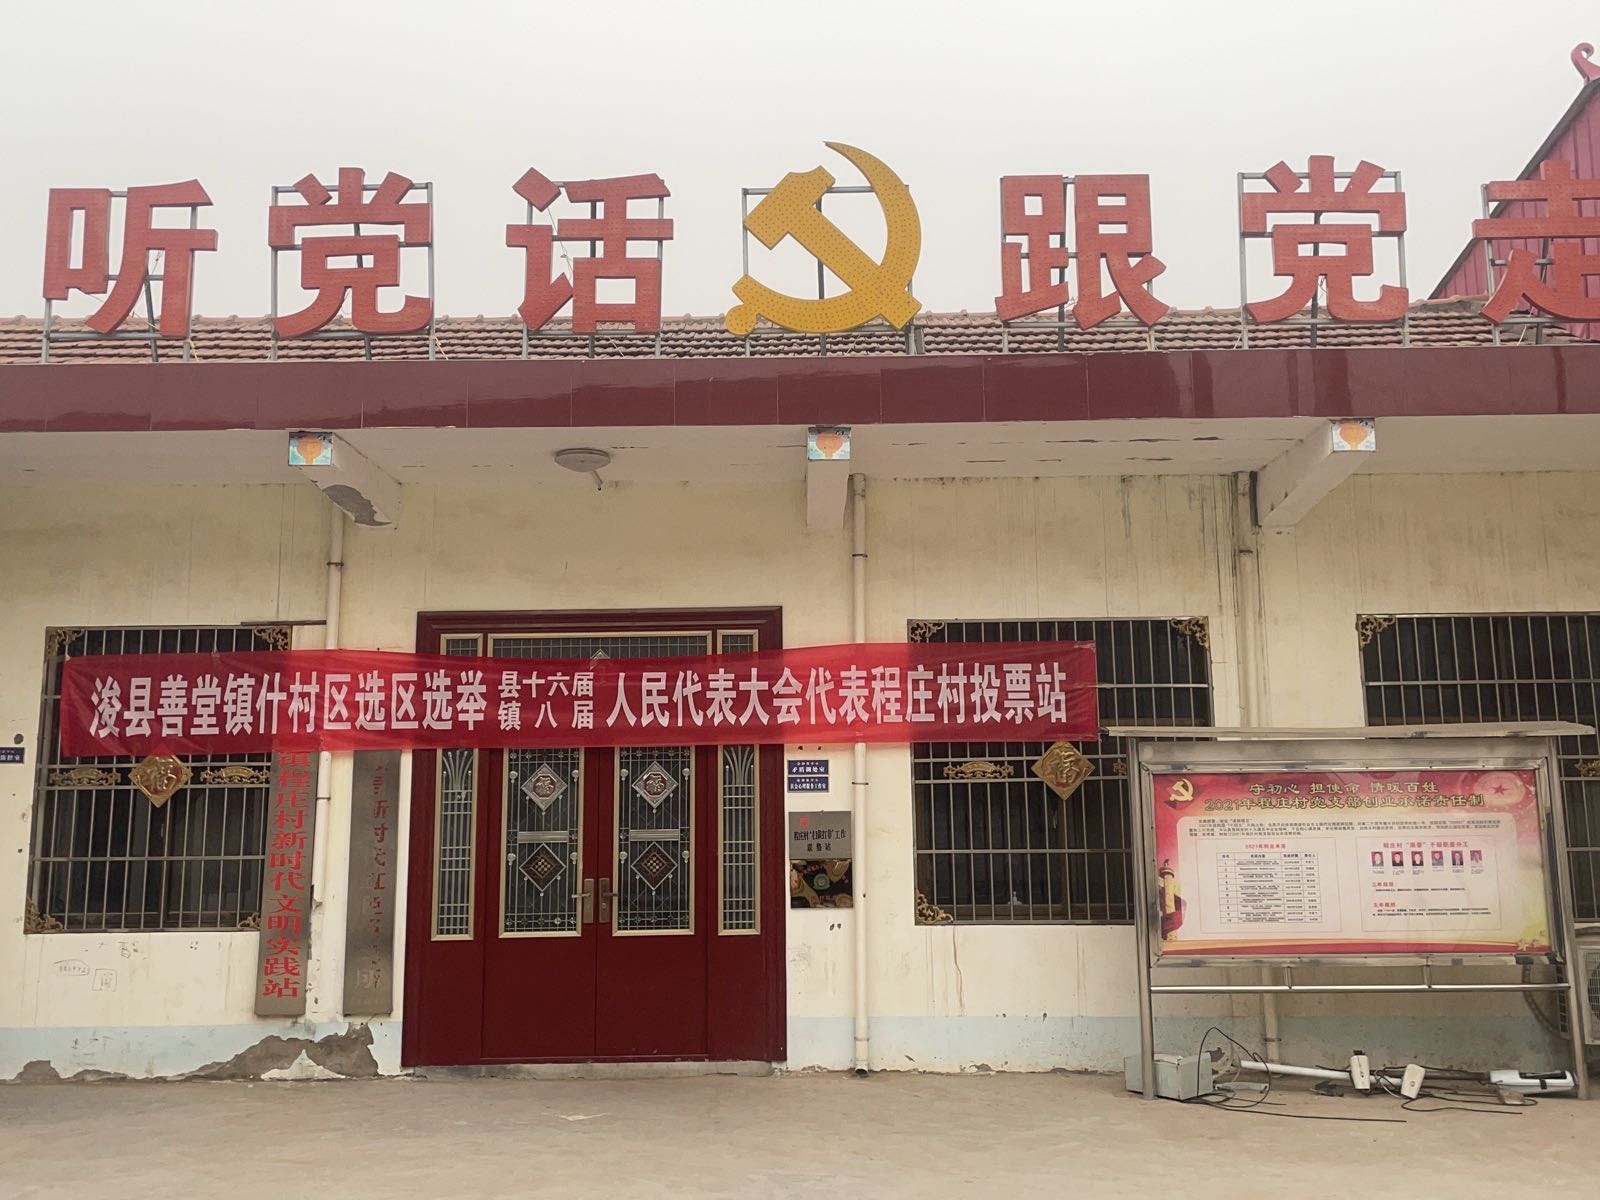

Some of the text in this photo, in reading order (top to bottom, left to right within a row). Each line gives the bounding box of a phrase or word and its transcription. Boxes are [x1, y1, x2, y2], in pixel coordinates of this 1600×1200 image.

[42, 155, 1600, 340] 听党话 跟党走
[89, 661, 1067, 738] 浚县善堂镇什村区选区选举 人民代表大会代表程庄村投票站
[497, 670, 594, 699] 县十六届
[497, 700, 594, 731] 镇八届
[1249, 781, 1439, 796] 守初心 担使命 情暖百姓
